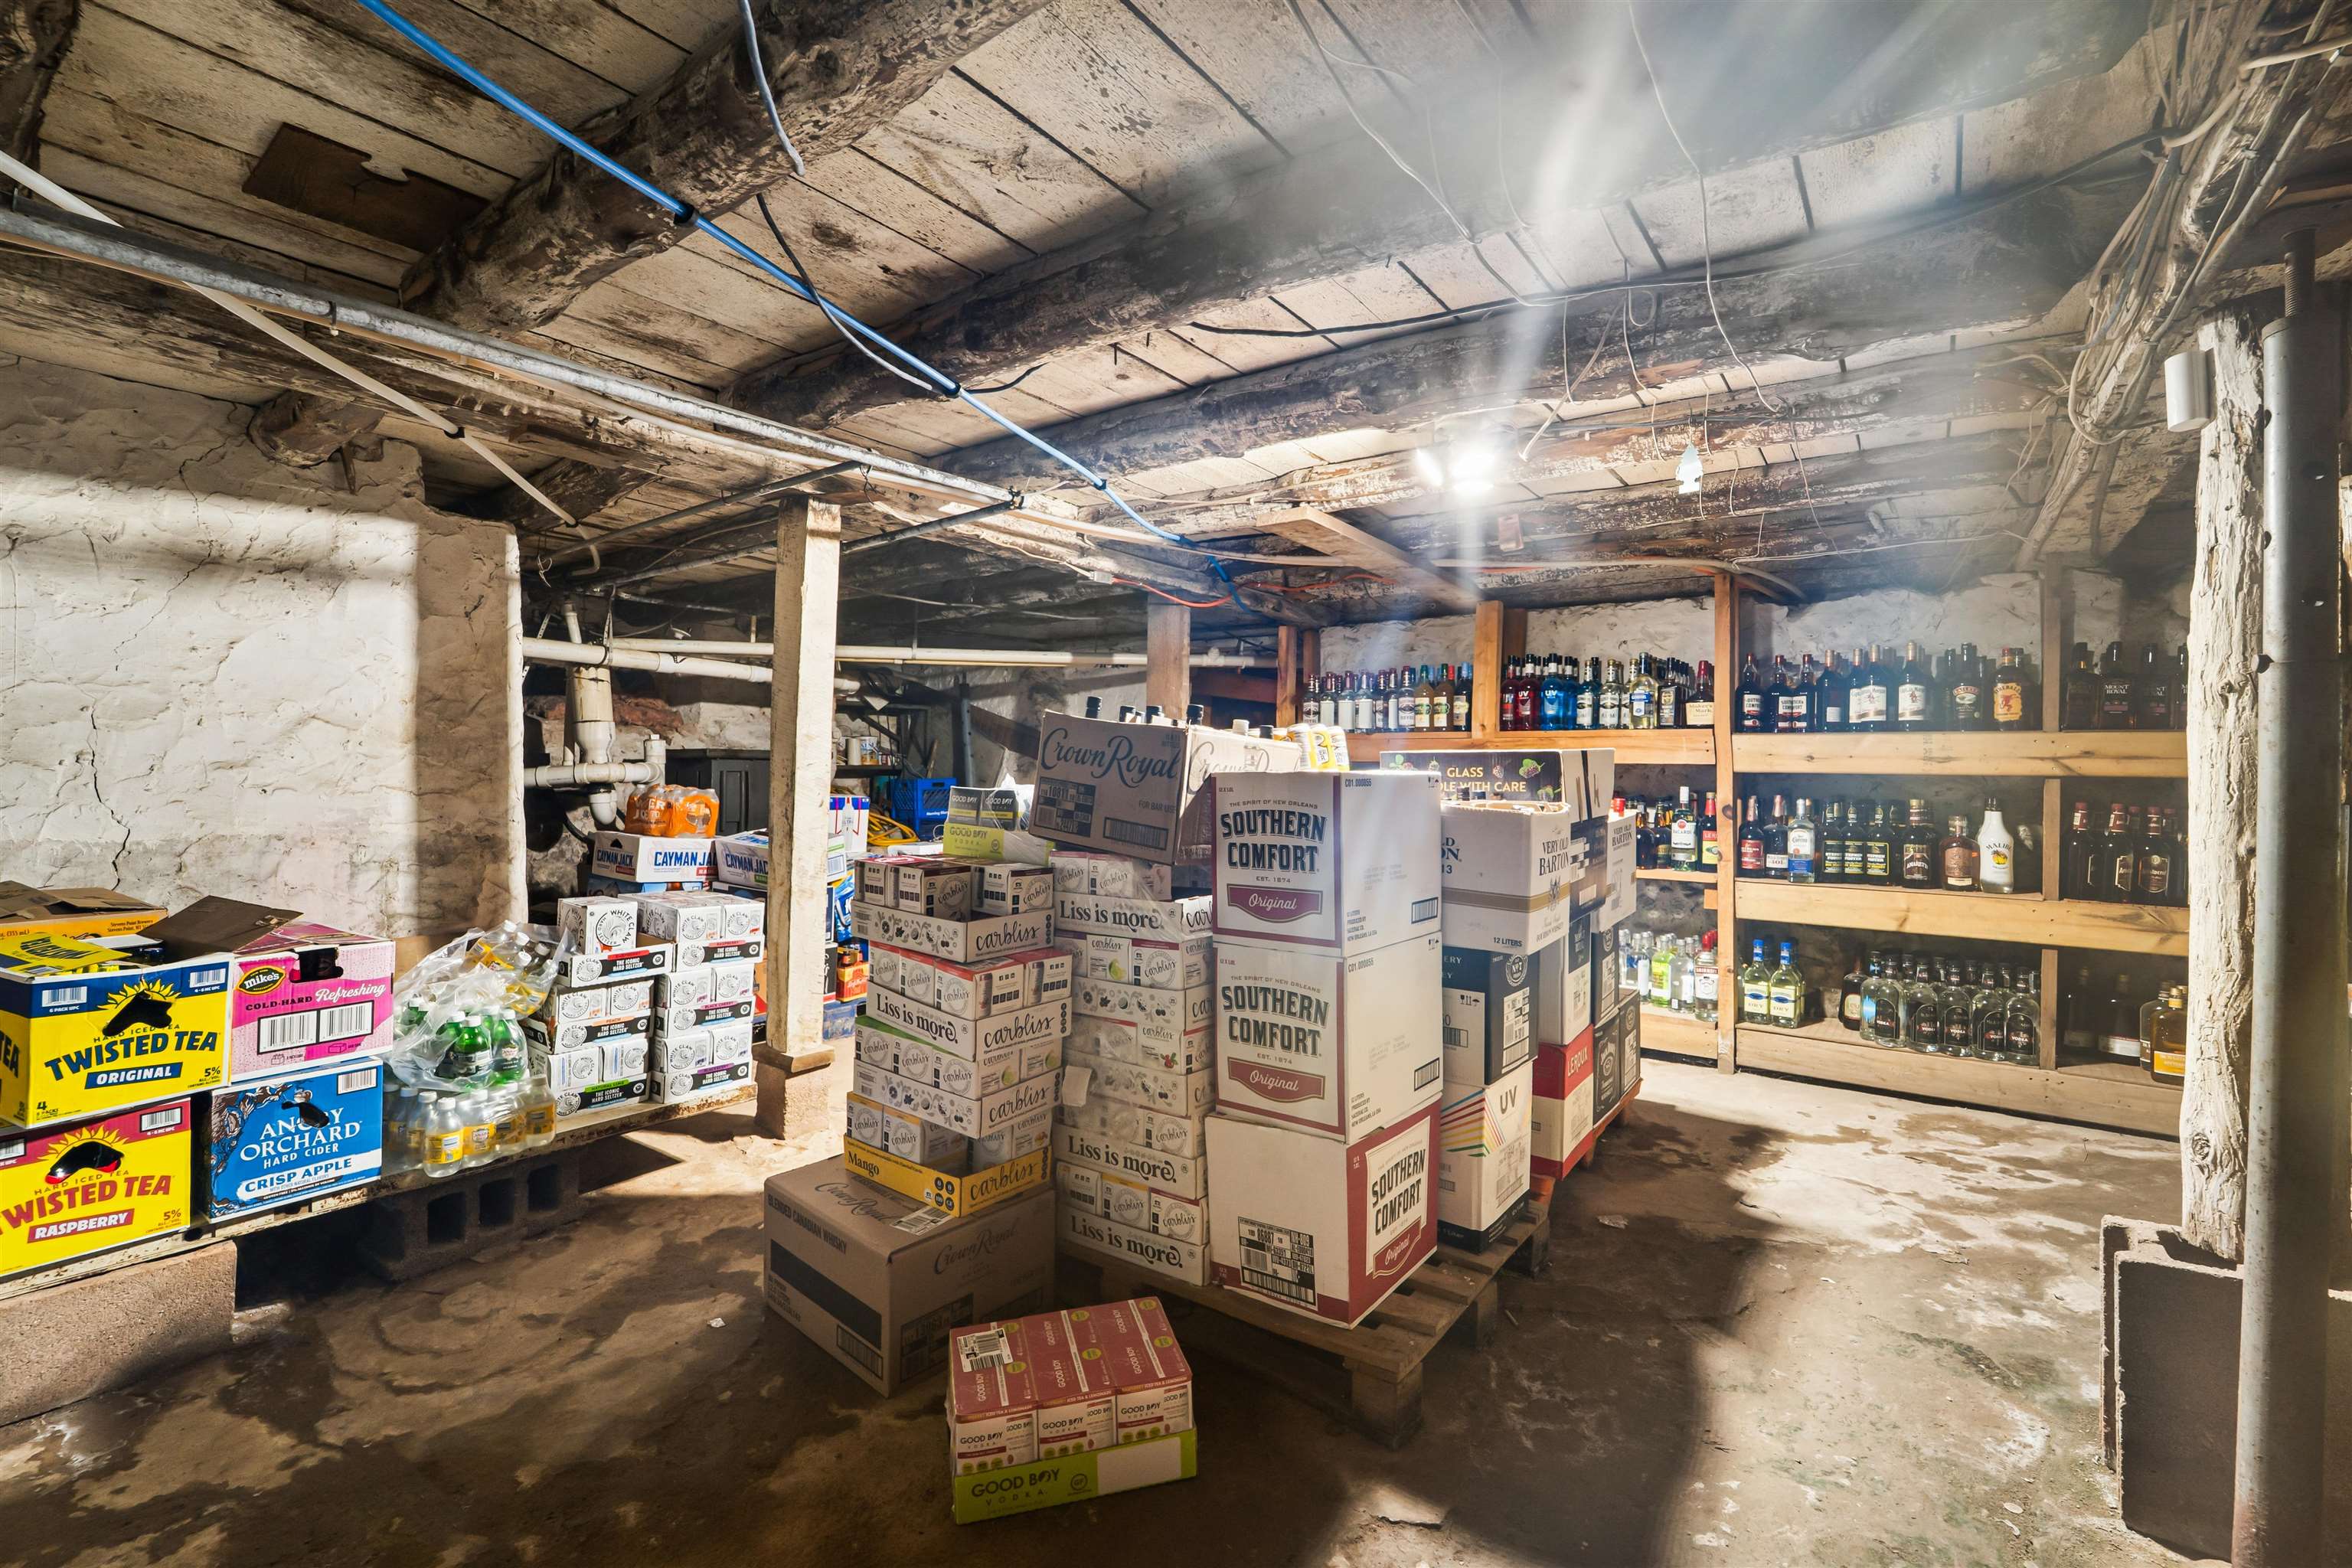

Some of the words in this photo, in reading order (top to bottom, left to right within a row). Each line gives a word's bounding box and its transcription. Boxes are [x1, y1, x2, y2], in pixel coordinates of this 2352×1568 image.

[1041, 727, 1106, 770] Crown
[1091, 736, 1181, 789] Royal
[1446, 767, 1484, 778] GLASS
[1459, 782, 1491, 792] WITH
[1494, 782, 1527, 792] CARE
[1139, 800, 1149, 809] FOR
[949, 827, 971, 836] GOOD
[1220, 809, 1328, 843] SOUTHERN
[1543, 839, 1558, 854] VERY
[1612, 831, 1632, 846] BARTON
[597, 849, 617, 864] CAYMAN
[618, 854, 633, 867] JACK
[654, 851, 697, 867] CAYMAN
[725, 854, 753, 871] CAYMAN
[754, 858, 768, 874] JAC
[1227, 842, 1319, 874] COMFORT
[1095, 903, 1108, 923] is
[1249, 893, 1297, 911] Original
[976, 921, 1040, 950] carbliss
[1501, 938, 1522, 947] LITERS
[626, 962, 642, 970] SELTZER
[244, 972, 280, 989] mike's
[1290, 982, 1321, 993] ORLEANS
[315, 983, 386, 1003] Refreshing
[877, 993, 900, 1019] Liss
[903, 1007, 913, 1024] is
[1221, 985, 1329, 1028] SOUTHERN
[985, 1015, 1054, 1047] carbliss
[1228, 1015, 1320, 1058] COMFORT
[44, 1035, 169, 1081] TWISTED
[174, 1031, 218, 1051] TEA
[1274, 1056, 1292, 1064] 1874
[1568, 1047, 1588, 1077] LEROUX
[96, 1066, 172, 1085] ORIGINAL
[204, 1066, 220, 1077] 5%
[1250, 1070, 1299, 1091] Original
[603, 1093, 622, 1102] SELTZER
[989, 1084, 1050, 1122] carbliss
[1499, 1085, 1517, 1114] UV
[260, 1108, 344, 1140] ANGY
[240, 1122, 361, 1161] ORCHARD
[1068, 1135, 1100, 1161] Liss
[1105, 1145, 1119, 1166] is
[264, 1152, 298, 1169] HARD
[305, 1143, 339, 1157] CIDER
[848, 1151, 880, 1176] Mango
[34, 1181, 69, 1195] HARD
[75, 1174, 103, 1184] ICED
[245, 1171, 296, 1193] CRISP
[302, 1158, 352, 1179] APPLE
[969, 1162, 1038, 1200] carbliss
[1371, 1148, 1426, 1208] SOUTHERN
[0, 1180, 118, 1236] WISTED
[124, 1175, 172, 1197] TEA
[163, 1208, 181, 1220] 5%
[1374, 1178, 1421, 1236] COMFORT
[35, 1212, 129, 1240] RASPBERRY
[768, 1194, 792, 1219] BLENDED
[793, 1211, 822, 1239] CANADIAN
[823, 1230, 847, 1254] WHISKY
[1072, 1214, 1103, 1242] Liss
[1385, 1233, 1410, 1266] Original
[1042, 1421, 1067, 1429] GOOD
[960, 1436, 985, 1444] GOOD
[972, 1475, 1023, 1498] GOOD
